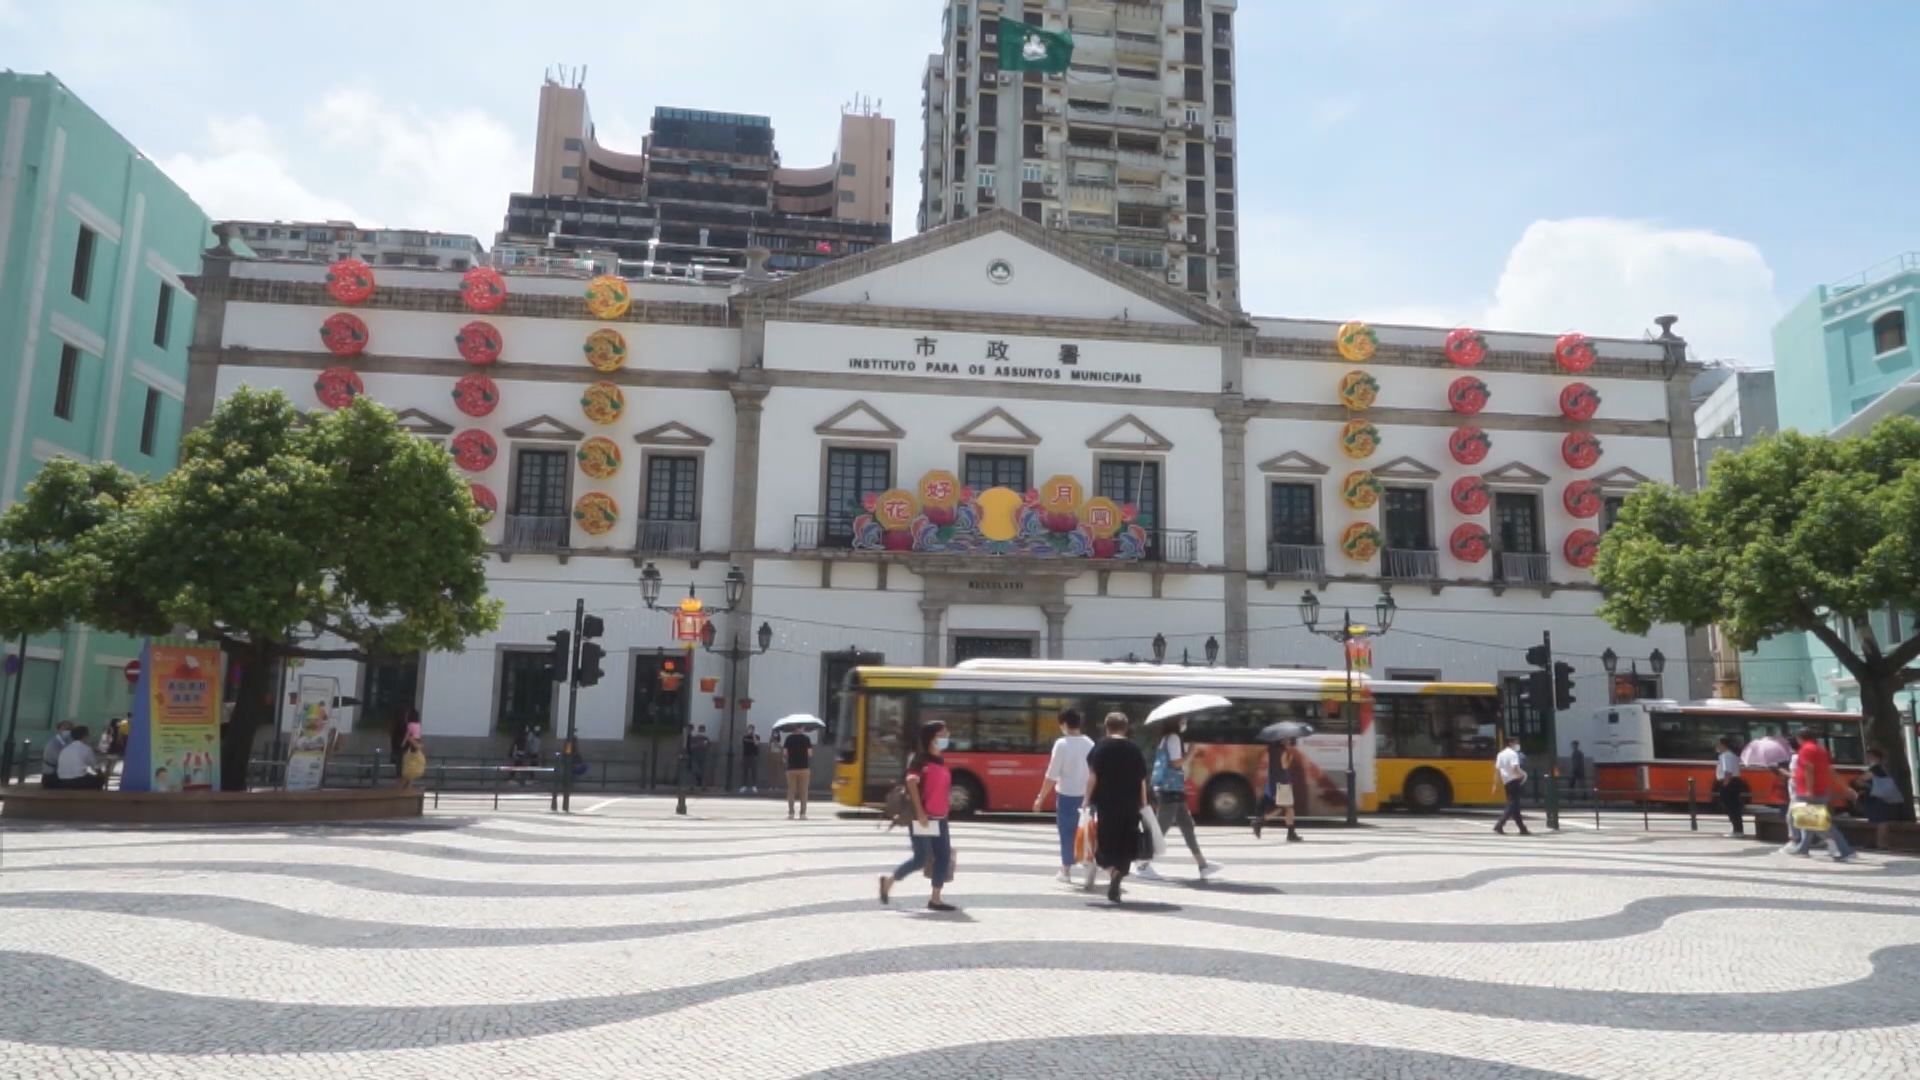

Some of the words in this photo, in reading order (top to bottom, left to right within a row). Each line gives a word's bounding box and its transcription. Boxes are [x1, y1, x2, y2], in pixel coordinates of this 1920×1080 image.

[849, 358, 915, 371] INSTITUTO
[926, 362, 959, 374] PARA
[968, 365, 985, 376] OS
[994, 366, 1060, 379] ASSUNTOS
[1070, 370, 1142, 383] MUNICIPAIS
